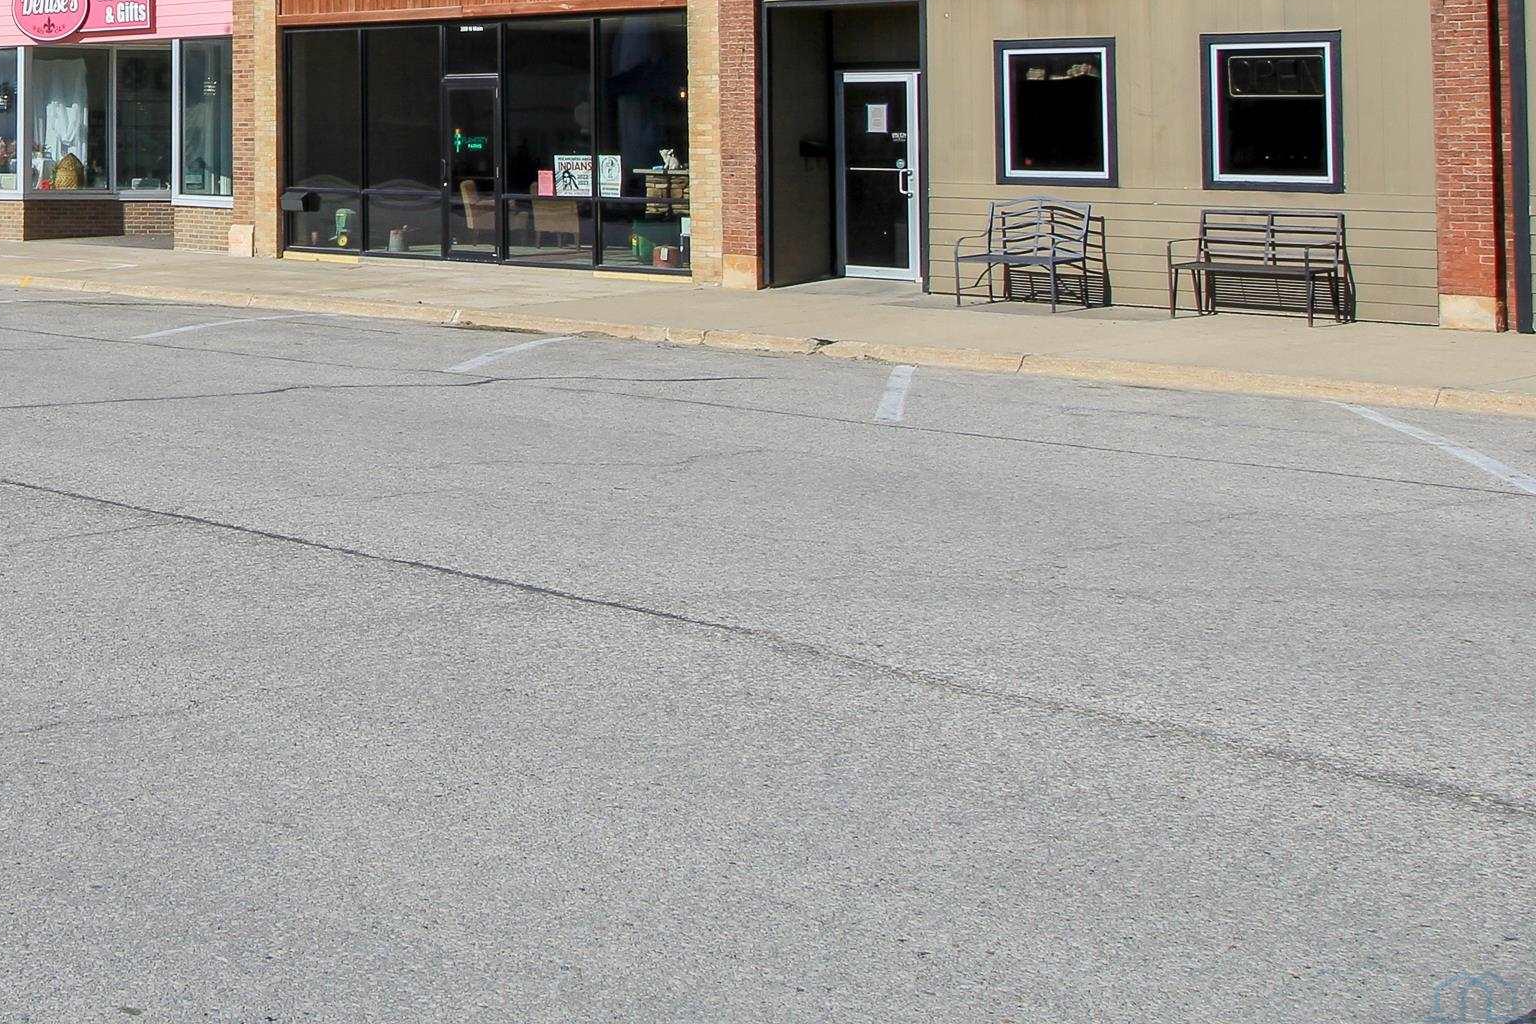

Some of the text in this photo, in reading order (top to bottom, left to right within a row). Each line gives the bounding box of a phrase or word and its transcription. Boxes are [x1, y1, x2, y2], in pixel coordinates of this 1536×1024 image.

[105, 1, 147, 24] & Gifts
[559, 161, 593, 171] INDIANS
